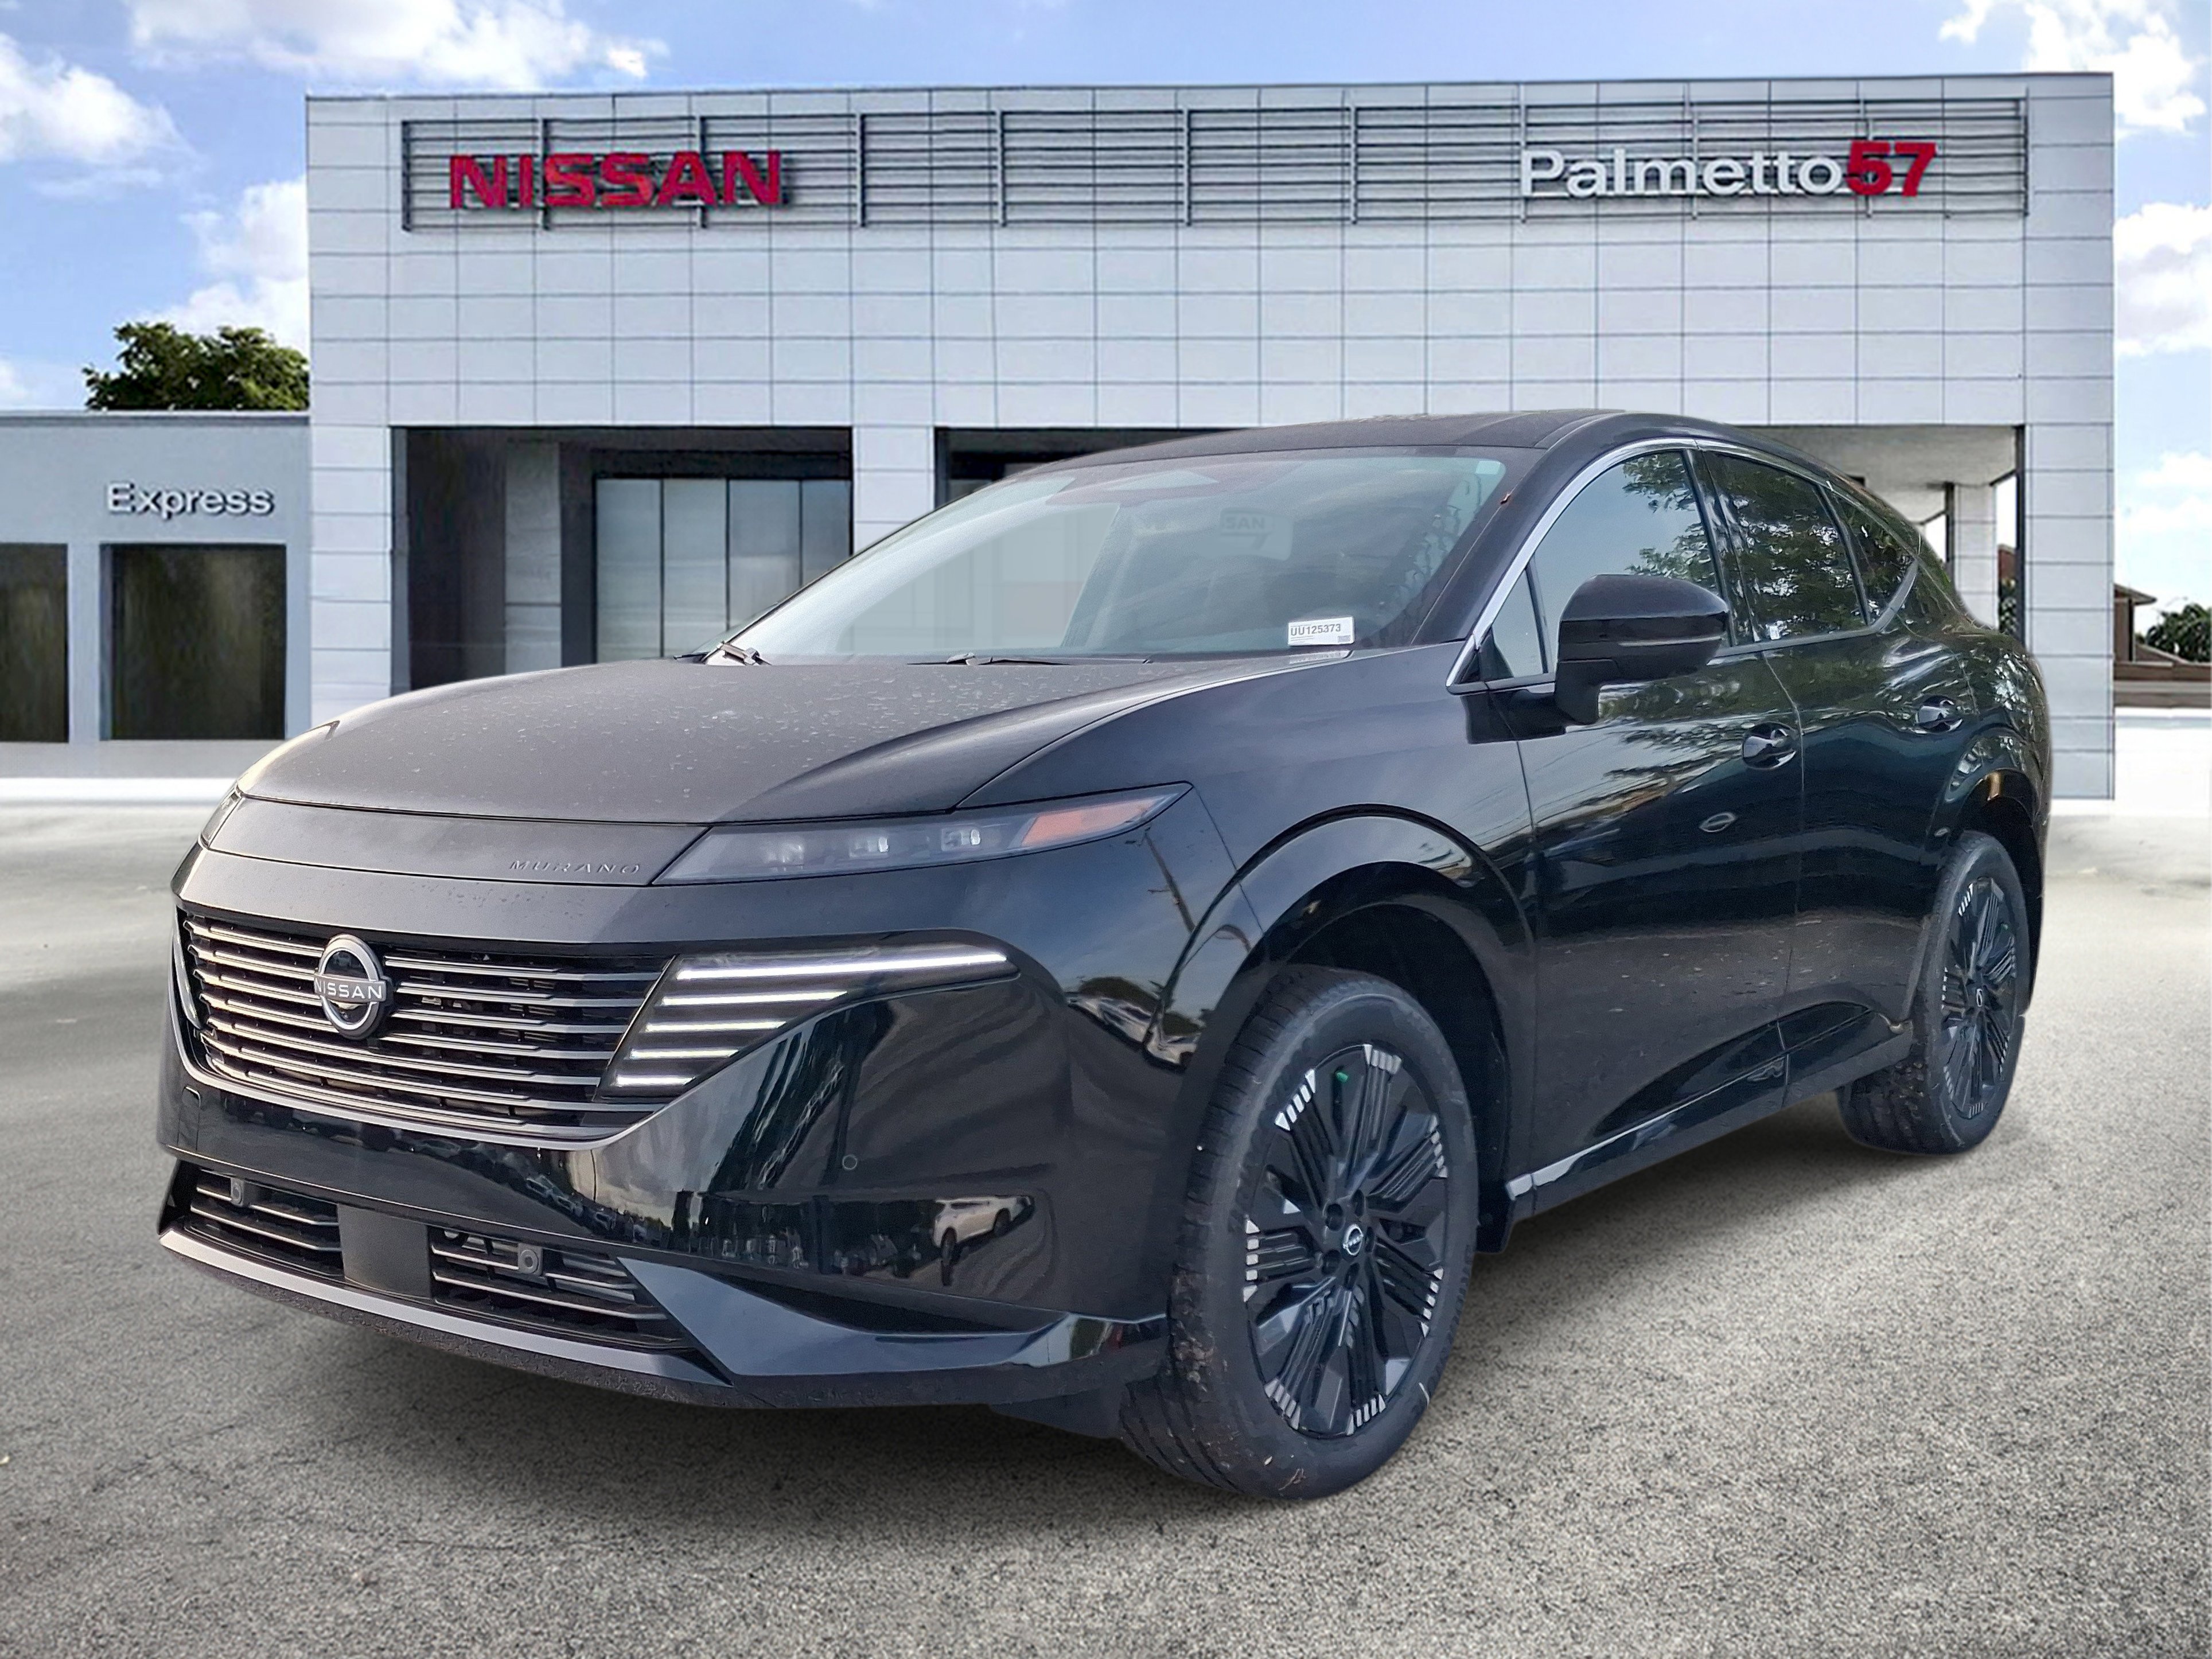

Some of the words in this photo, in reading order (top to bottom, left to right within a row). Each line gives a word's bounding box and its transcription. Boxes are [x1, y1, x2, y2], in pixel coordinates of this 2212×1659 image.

[450, 150, 781, 208] NISSAN
[108, 482, 275, 520] Express
[509, 860, 640, 873] MURANO
[315, 978, 383, 999] NISSAN
